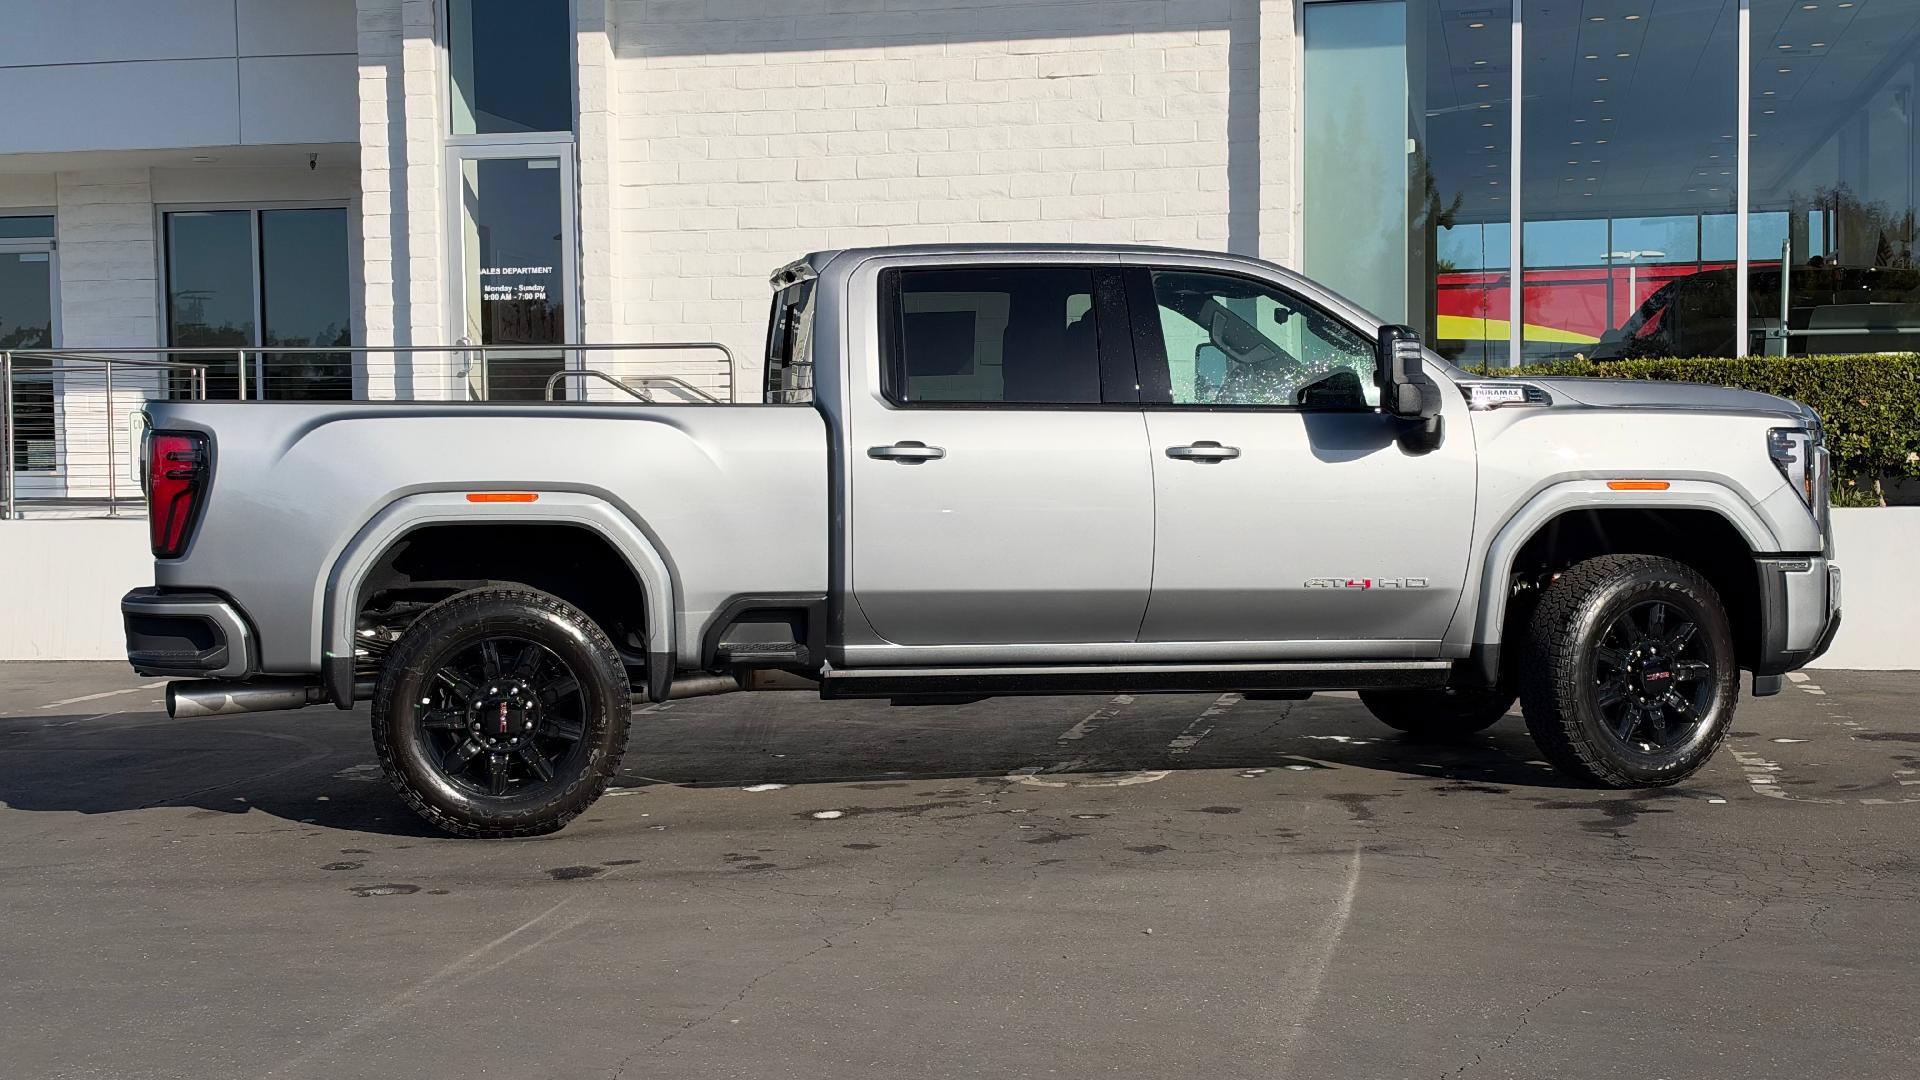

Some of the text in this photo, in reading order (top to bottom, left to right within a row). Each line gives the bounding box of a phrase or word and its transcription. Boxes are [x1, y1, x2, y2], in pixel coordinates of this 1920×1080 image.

[502, 266, 552, 274] DEPARTMENT
[484, 284, 512, 293] Monday
[518, 284, 545, 292] Sunday
[518, 292, 533, 300] 7:00
[534, 292, 546, 300] PM
